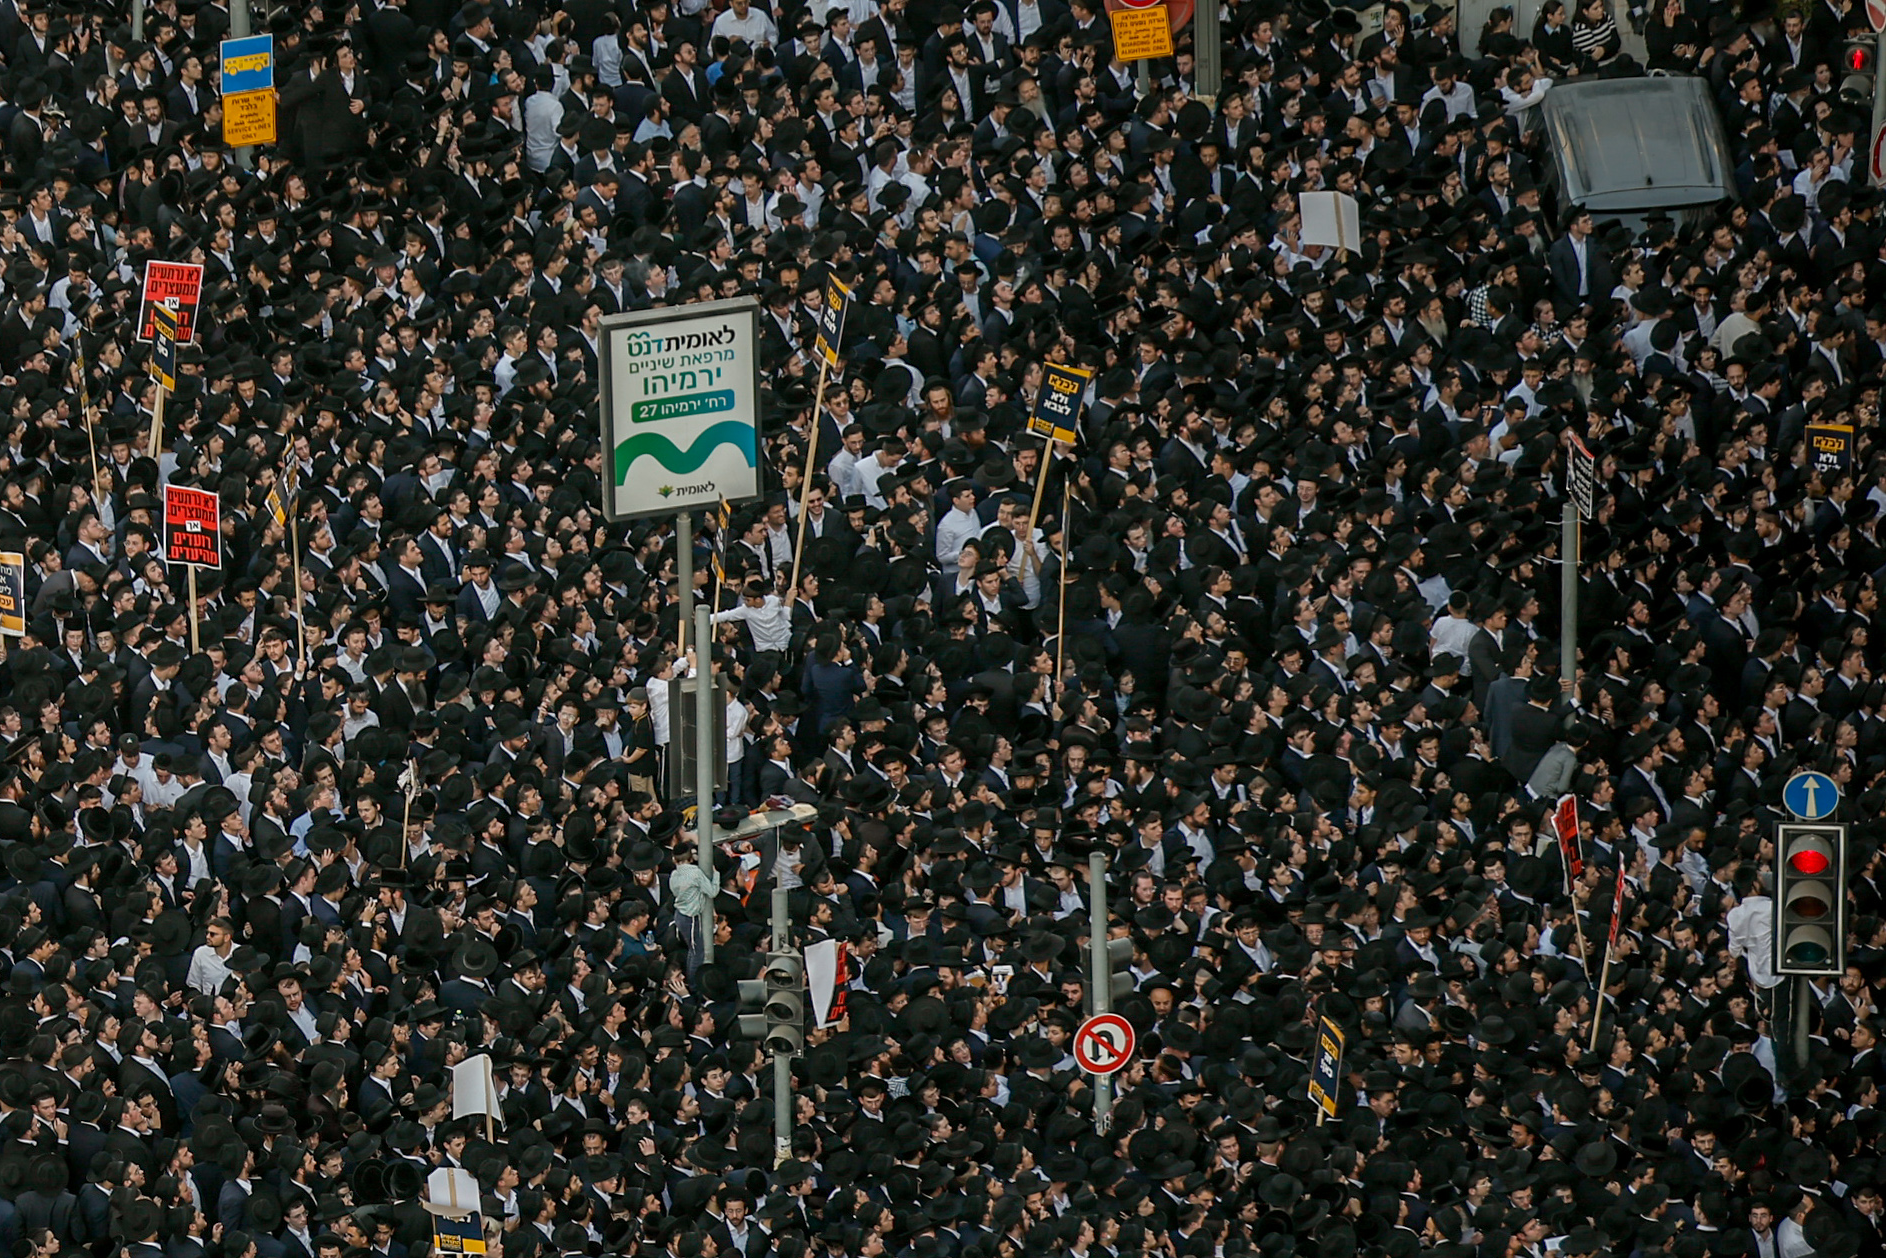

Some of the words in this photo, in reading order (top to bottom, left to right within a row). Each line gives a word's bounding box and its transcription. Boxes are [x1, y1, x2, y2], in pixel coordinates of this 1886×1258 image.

[227, 125, 251, 135] SERVICE
[254, 122, 271, 131] LINES
[242, 132, 257, 140] ONLY
[149, 266, 184, 279] נרתעים
[187, 269, 200, 281] לא
[629, 356, 674, 374] שיניים
[680, 349, 735, 367] מרפאת
[643, 367, 722, 395] ירמיהו
[1050, 375, 1077, 391] לכלא
[1050, 391, 1069, 404] ולא
[639, 404, 657, 418] 27
[661, 399, 701, 415] ירמיהו
[1043, 398, 1072, 416] לצבא
[1819, 452, 1837, 464] ולא
[676, 481, 715, 497] לאומית
[167, 490, 201, 505] נרתעים
[204, 496, 216, 509] לא
[168, 504, 215, 523] ממעצרים.
[187, 521, 199, 530] אך
[173, 531, 211, 549] רועדים
[168, 545, 218, 565] מהיעדים.
